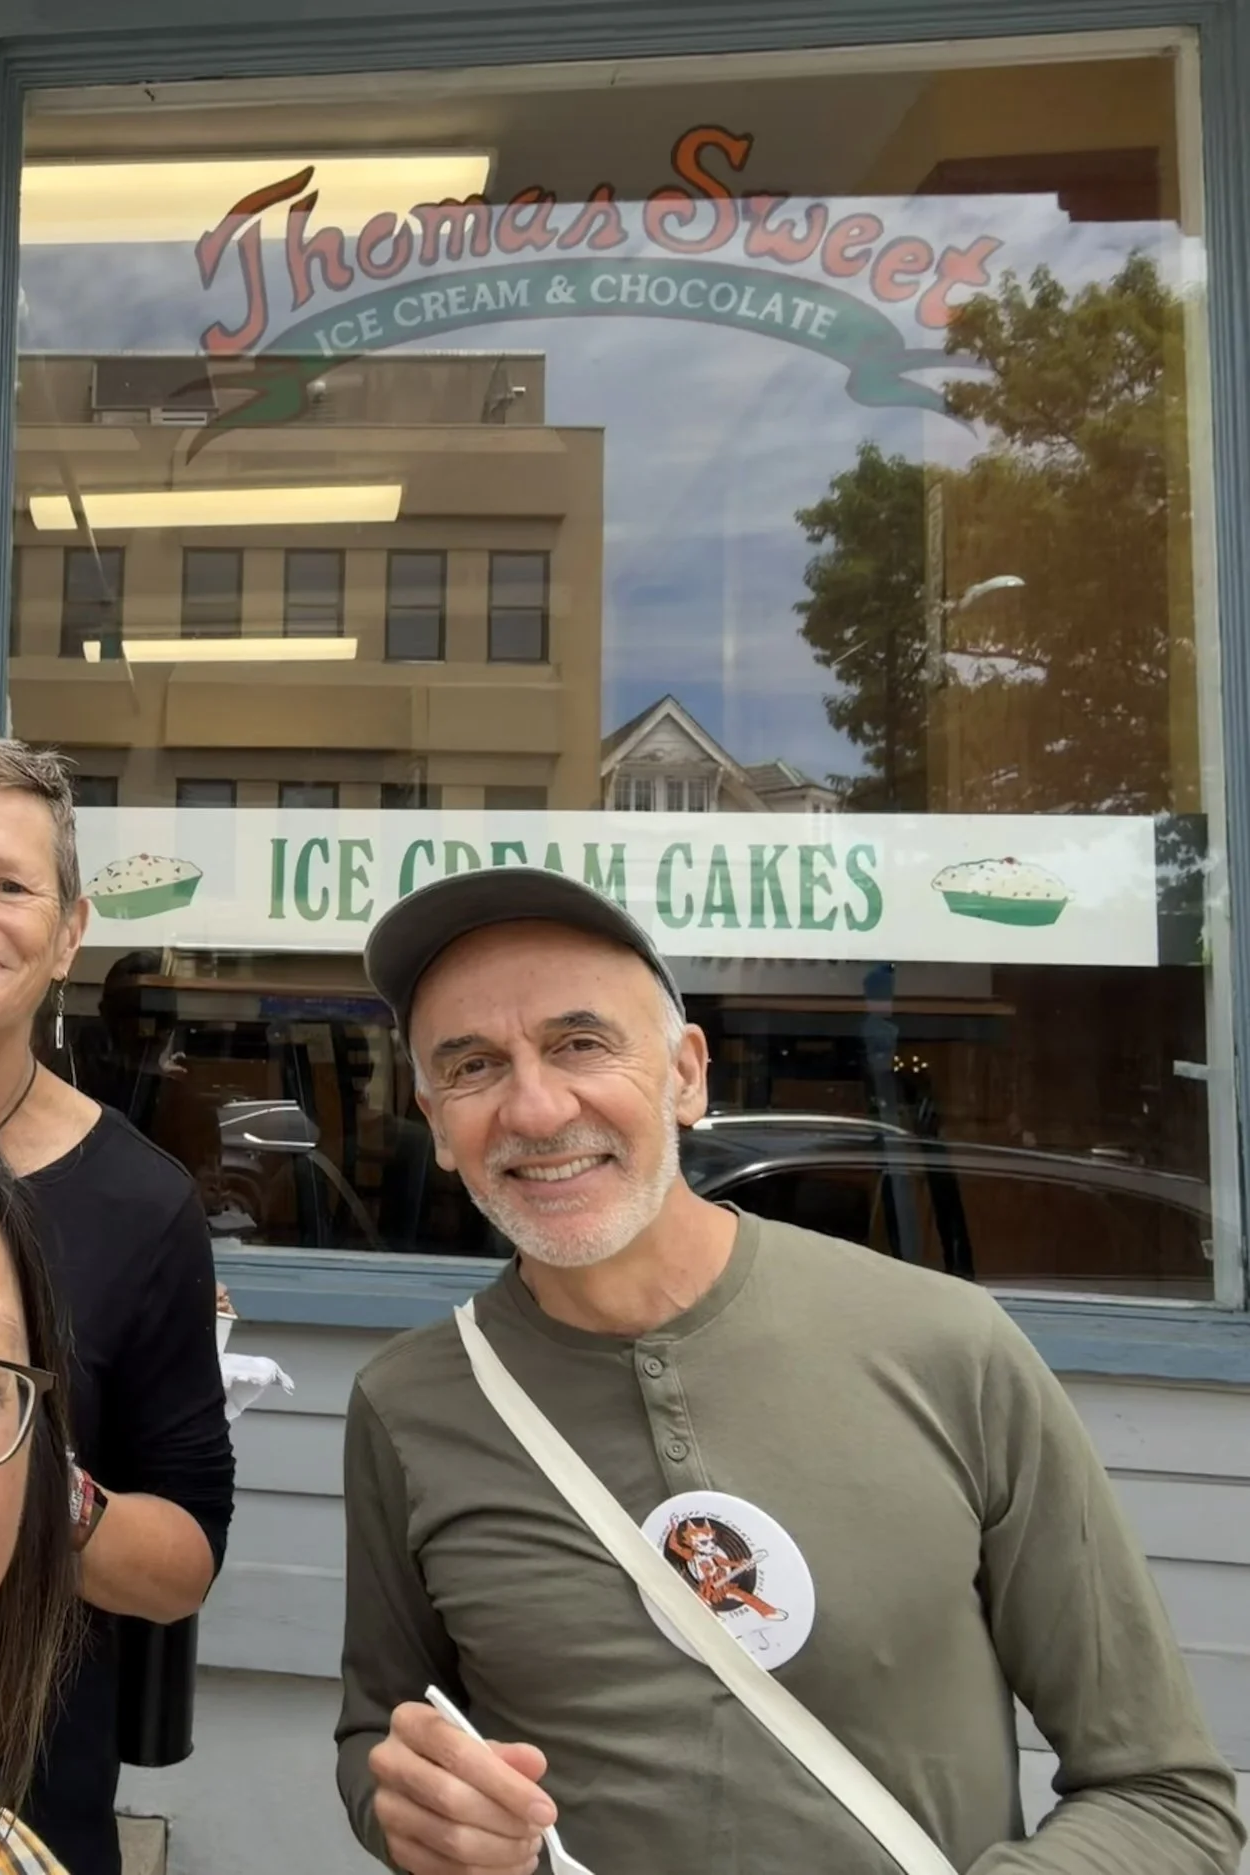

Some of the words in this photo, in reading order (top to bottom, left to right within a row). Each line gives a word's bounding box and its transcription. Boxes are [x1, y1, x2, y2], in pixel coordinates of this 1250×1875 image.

[194, 165, 628, 358] Thomas
[642, 125, 1004, 330] Sweet
[314, 307, 383, 357] ICE
[393, 278, 530, 328] CREAM
[546, 274, 575, 304] &
[589, 273, 839, 340] CHOCOLATE
[268, 837, 374, 922] ICE
[655, 842, 884, 932] CAKES
